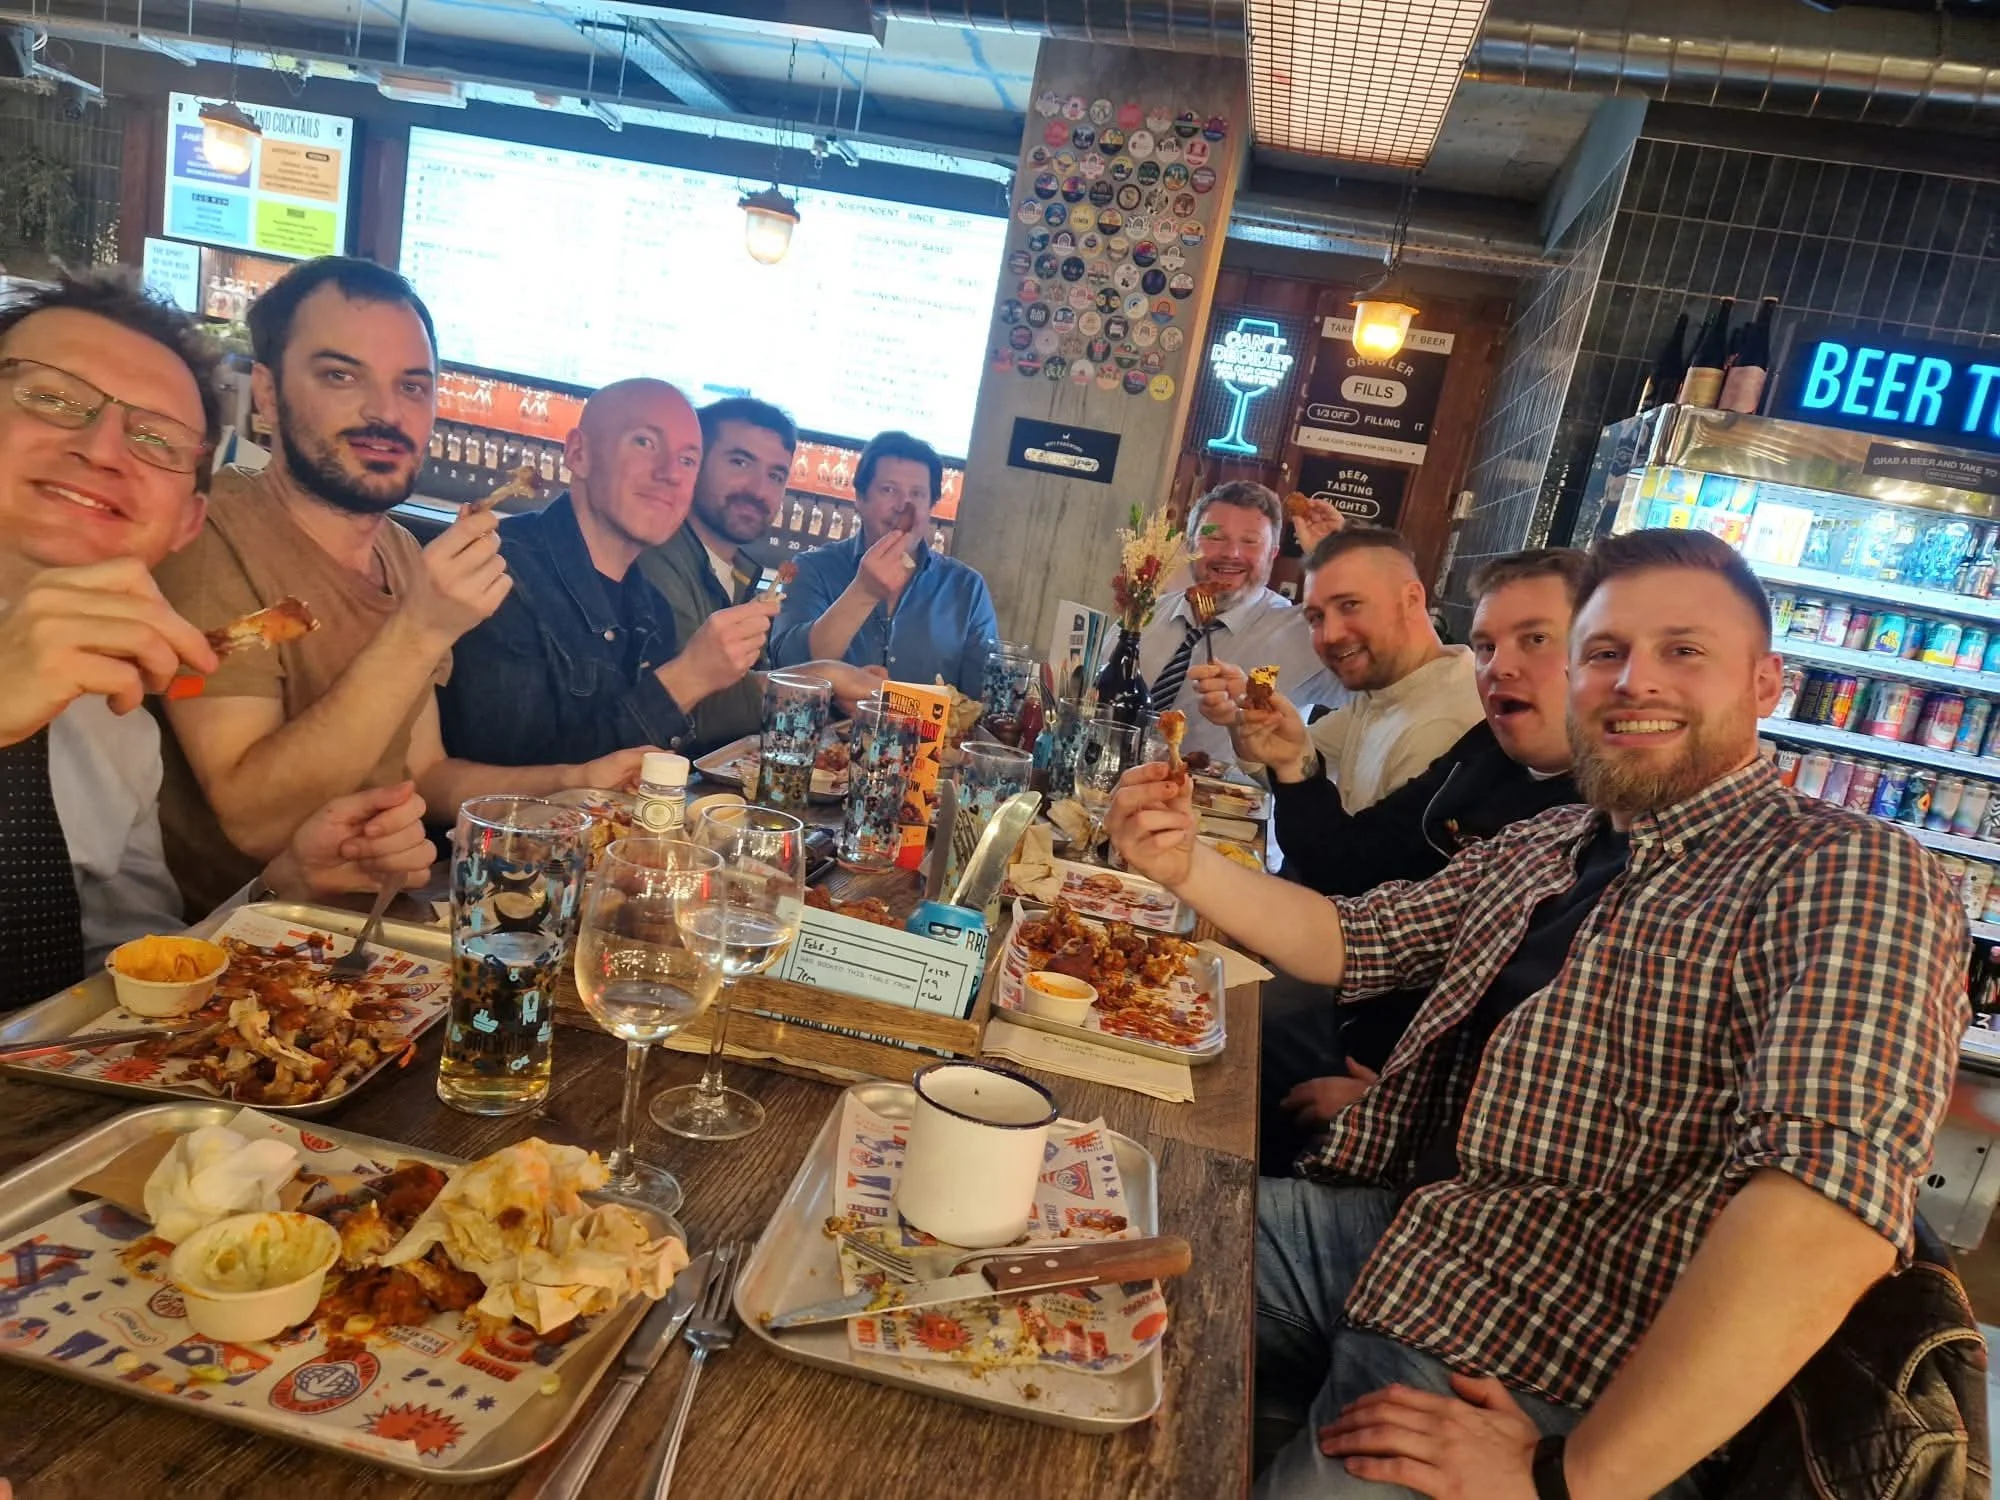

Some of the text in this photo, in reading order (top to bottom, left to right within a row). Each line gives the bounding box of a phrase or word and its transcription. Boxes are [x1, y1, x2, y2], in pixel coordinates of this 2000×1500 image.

[273, 112, 320, 139] COCKTAILS
[835, 201, 900, 218] INDEPENDENT
[908, 211, 936, 224] SINCE
[922, 242, 953, 256] BASED
[1225, 331, 1287, 354] CAN'T
[1419, 336, 1446, 346] BEER
[1346, 357, 1414, 377] GROWLER
[1353, 382, 1394, 399] FILLS
[1802, 342, 2000, 437] BEER T
[1331, 410, 1351, 421] OFF
[1364, 415, 1401, 428] FILLING
[1414, 422, 1425, 431] IT
[1910, 457, 1935, 467] BEER
[1935, 460, 1957, 469] AND
[1959, 462, 1983, 474] TAKE
[1338, 470, 1369, 482] BEER
[1326, 481, 1373, 495] TASTING
[1323, 498, 1368, 513] FLIGHTS
[769, 537, 780, 546] 19
[788, 541, 800, 550] 20
